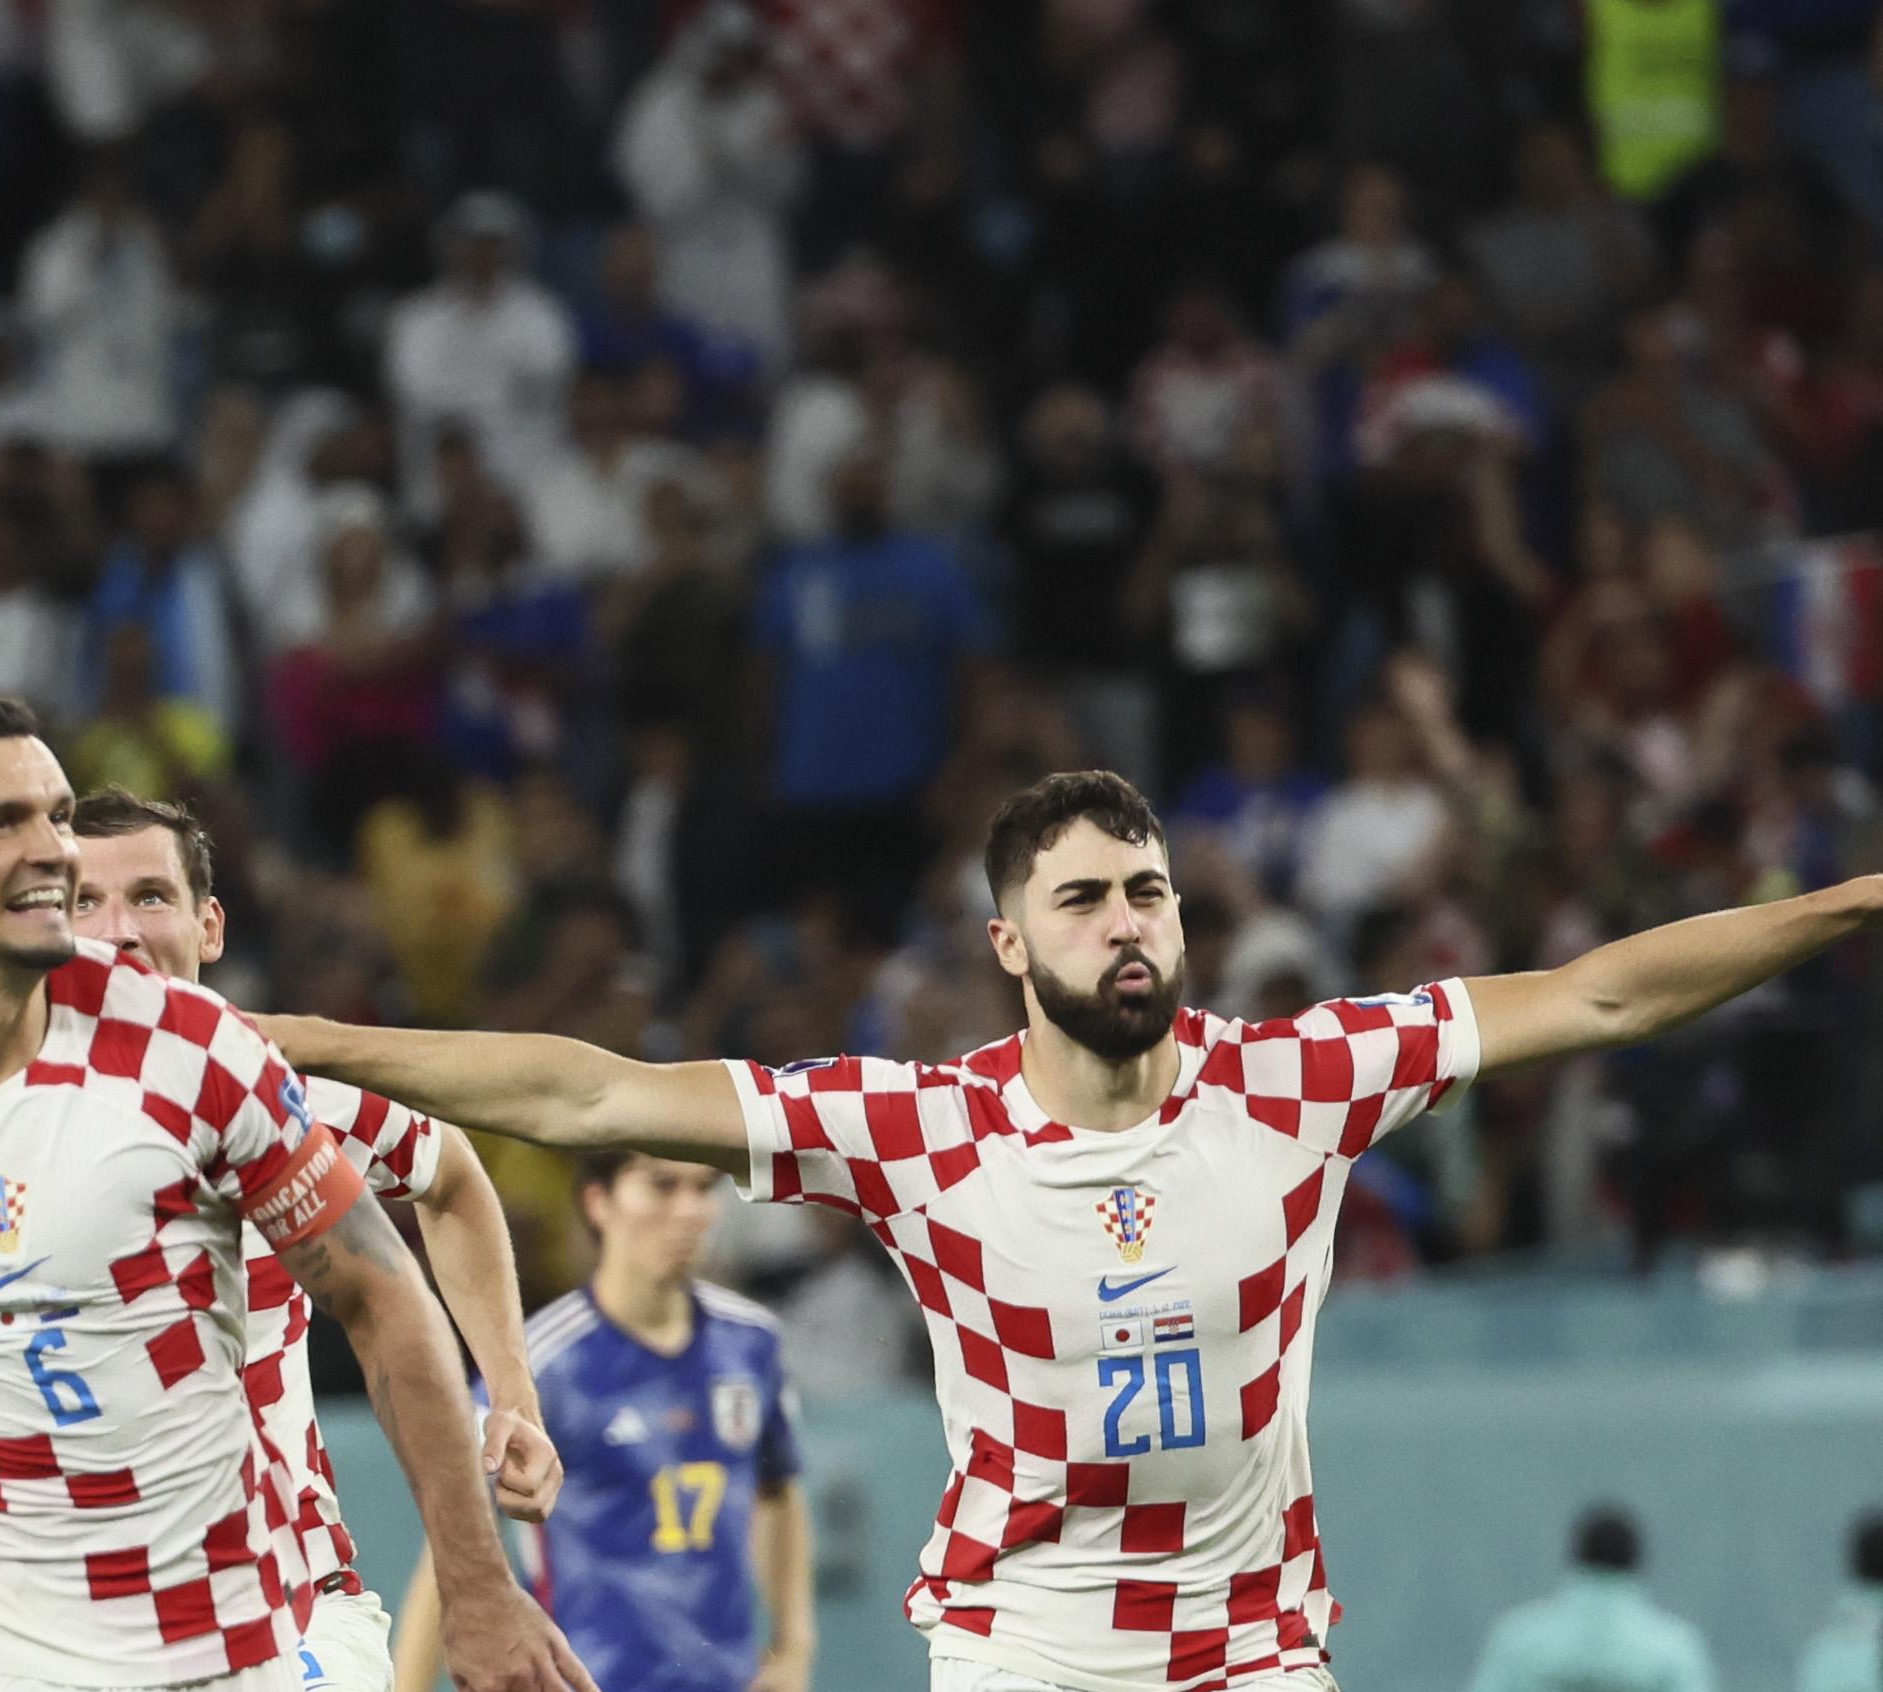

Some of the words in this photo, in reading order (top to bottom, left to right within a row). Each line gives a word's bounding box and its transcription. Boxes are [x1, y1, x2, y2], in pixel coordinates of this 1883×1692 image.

[294, 1188, 328, 1229] ALL
[24, 1327, 103, 1427] 6
[1097, 1347, 1207, 1458] 20
[650, 1460, 729, 1554] 17
